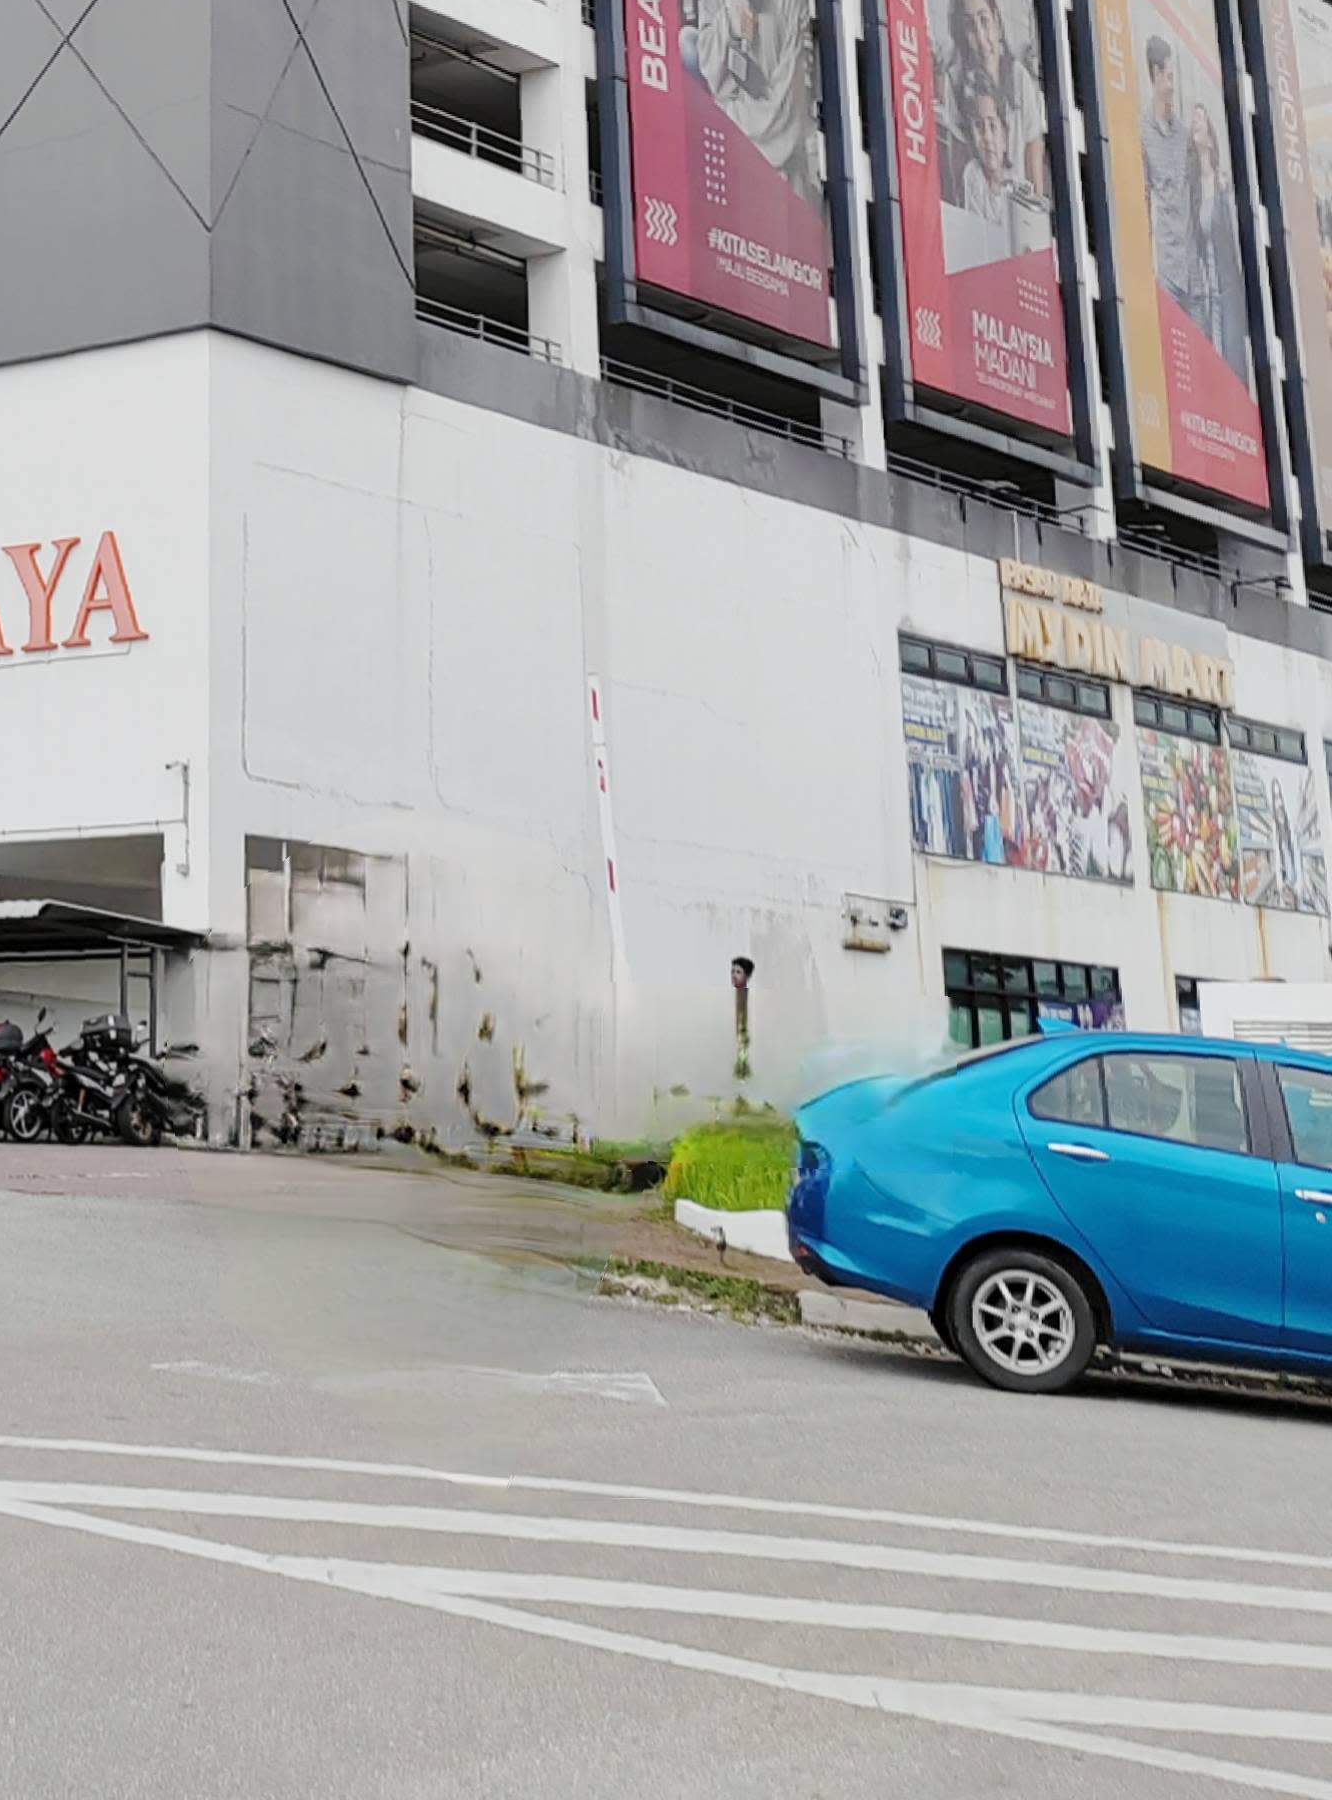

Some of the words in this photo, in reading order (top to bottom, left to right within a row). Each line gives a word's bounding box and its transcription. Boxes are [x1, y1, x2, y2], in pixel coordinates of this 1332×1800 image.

[896, 19, 927, 166] HOME
[708, 227, 824, 291] #KITASELANGOR
[972, 309, 1055, 369] MALAYSIA
[974, 340, 1037, 390] MADANI
